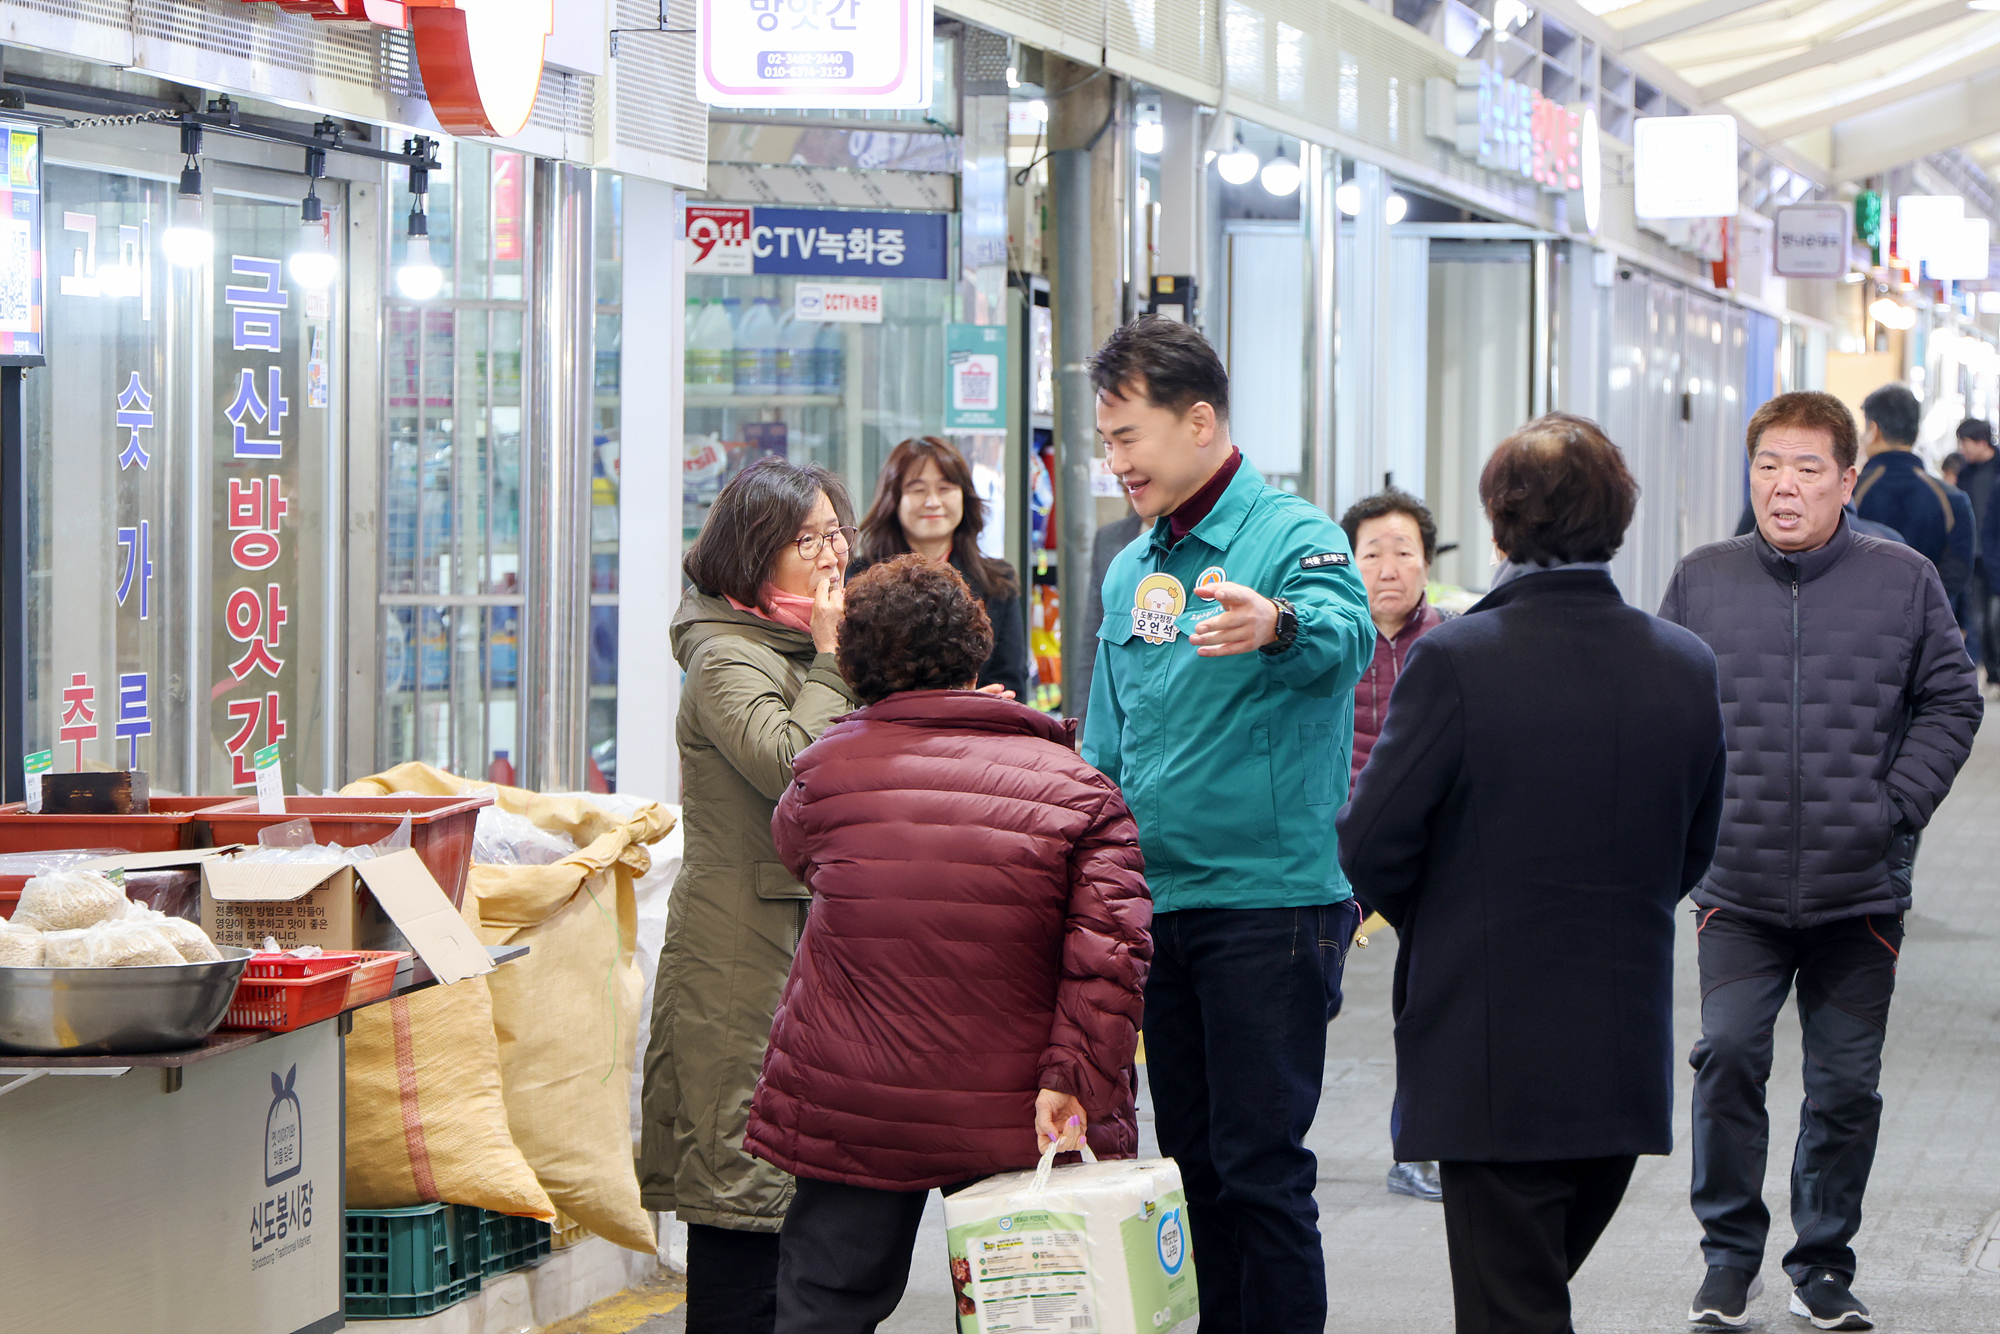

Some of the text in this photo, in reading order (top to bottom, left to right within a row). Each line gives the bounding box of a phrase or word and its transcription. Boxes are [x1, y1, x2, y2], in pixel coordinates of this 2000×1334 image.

[223, 254, 289, 789] 금산방앗간
[1305, 553, 1346, 566] 서울 도봉구
[1140, 611, 1173, 625] 도봉구청장
[215, 906, 325, 917] 전통적인 방법으로 만들어
[215, 918, 328, 930] 영양이 풍부하고 맛이 좋은
[215, 931, 243, 942] 저공해
[246, 931, 266, 942] 메주
[273, 1143, 293, 1167] 맛을 담은
[250, 1180, 314, 1252] 신도봉시장
[275, 1240, 297, 1260] Traditional
[296, 1233, 312, 1249] Market
